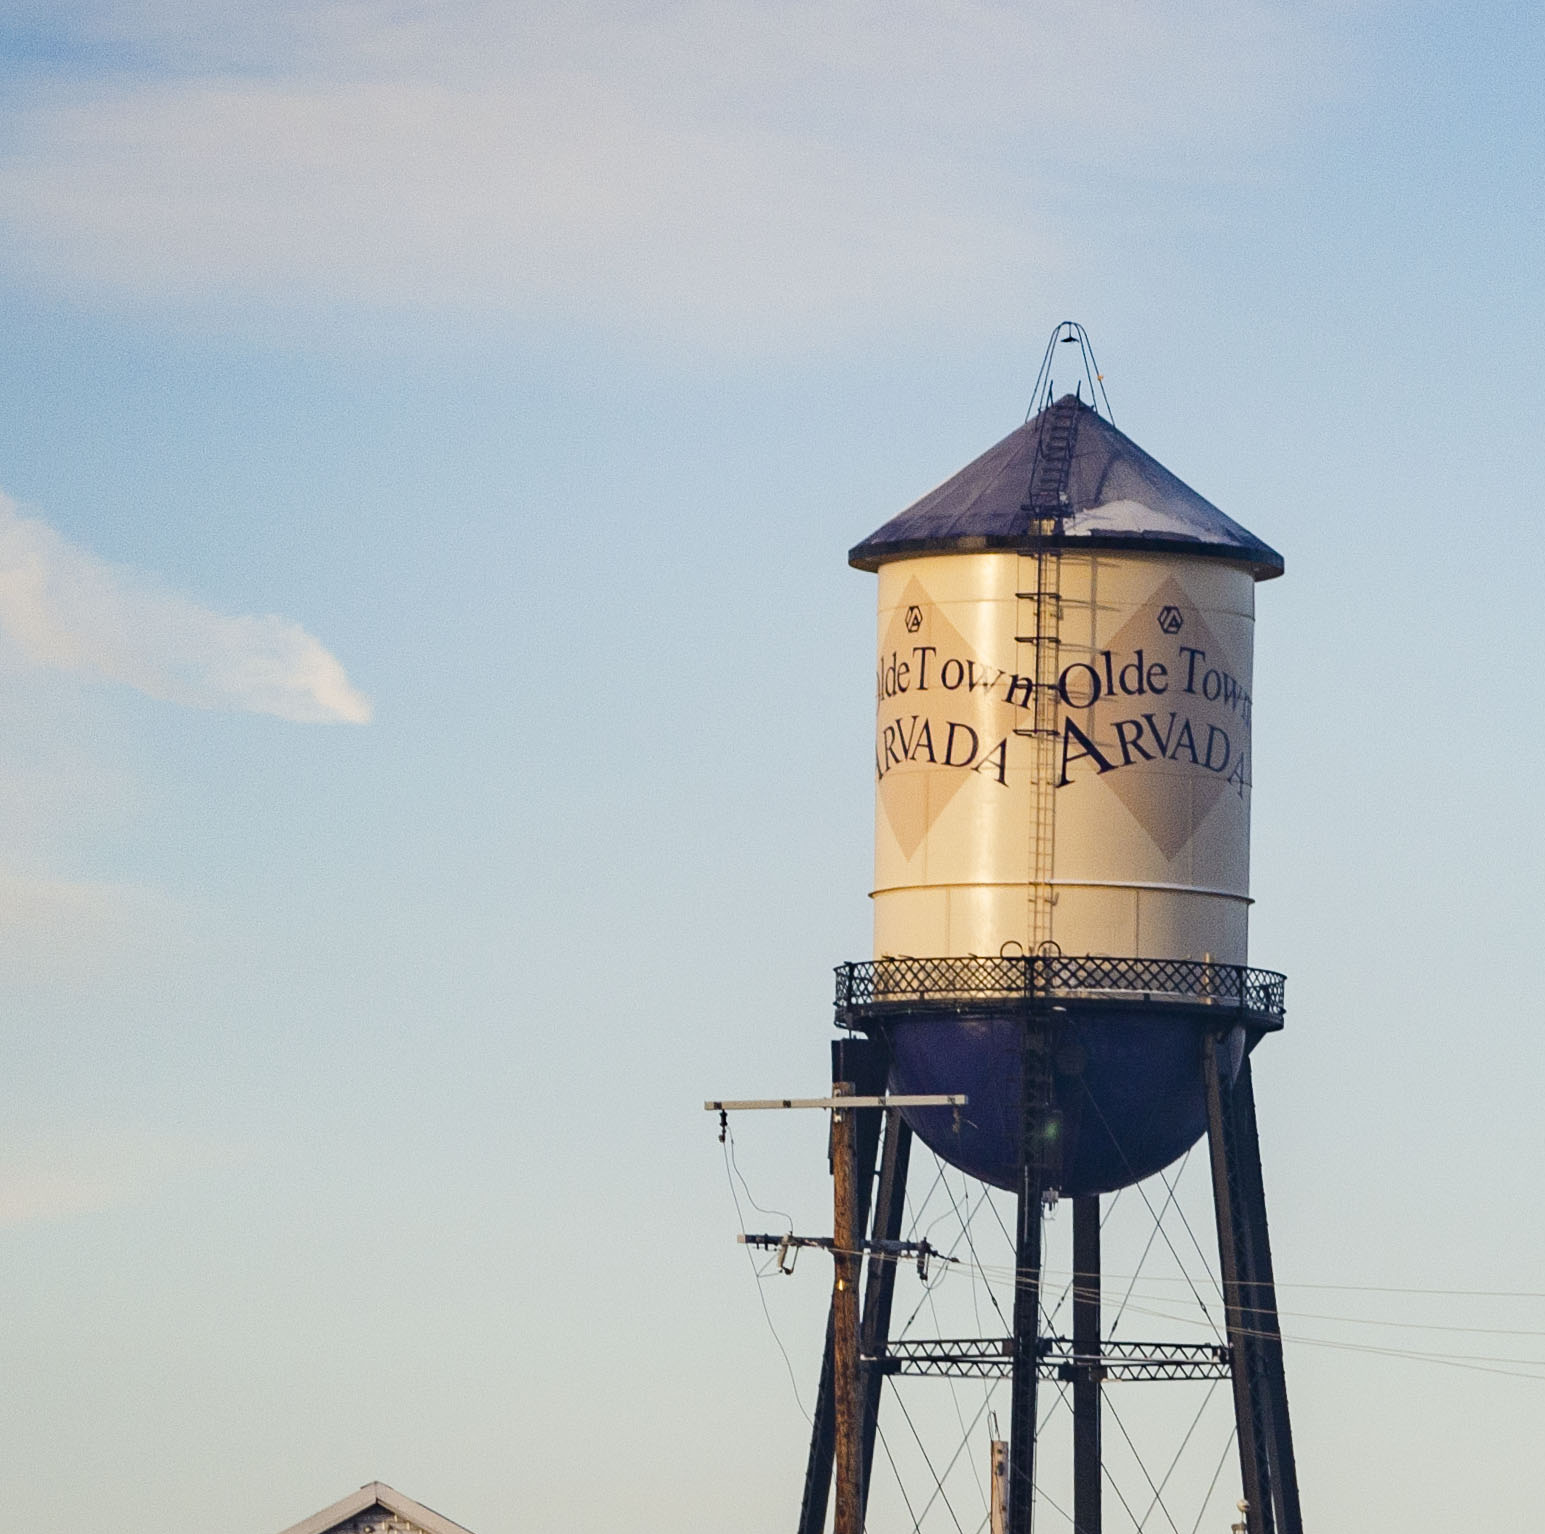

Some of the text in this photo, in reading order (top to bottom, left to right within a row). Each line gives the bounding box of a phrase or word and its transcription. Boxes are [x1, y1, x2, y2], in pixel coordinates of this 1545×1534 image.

[913, 646, 1034, 710] Town
[1058, 646, 1252, 728] Olde Town
[1055, 711, 1252, 799] ARVADA
